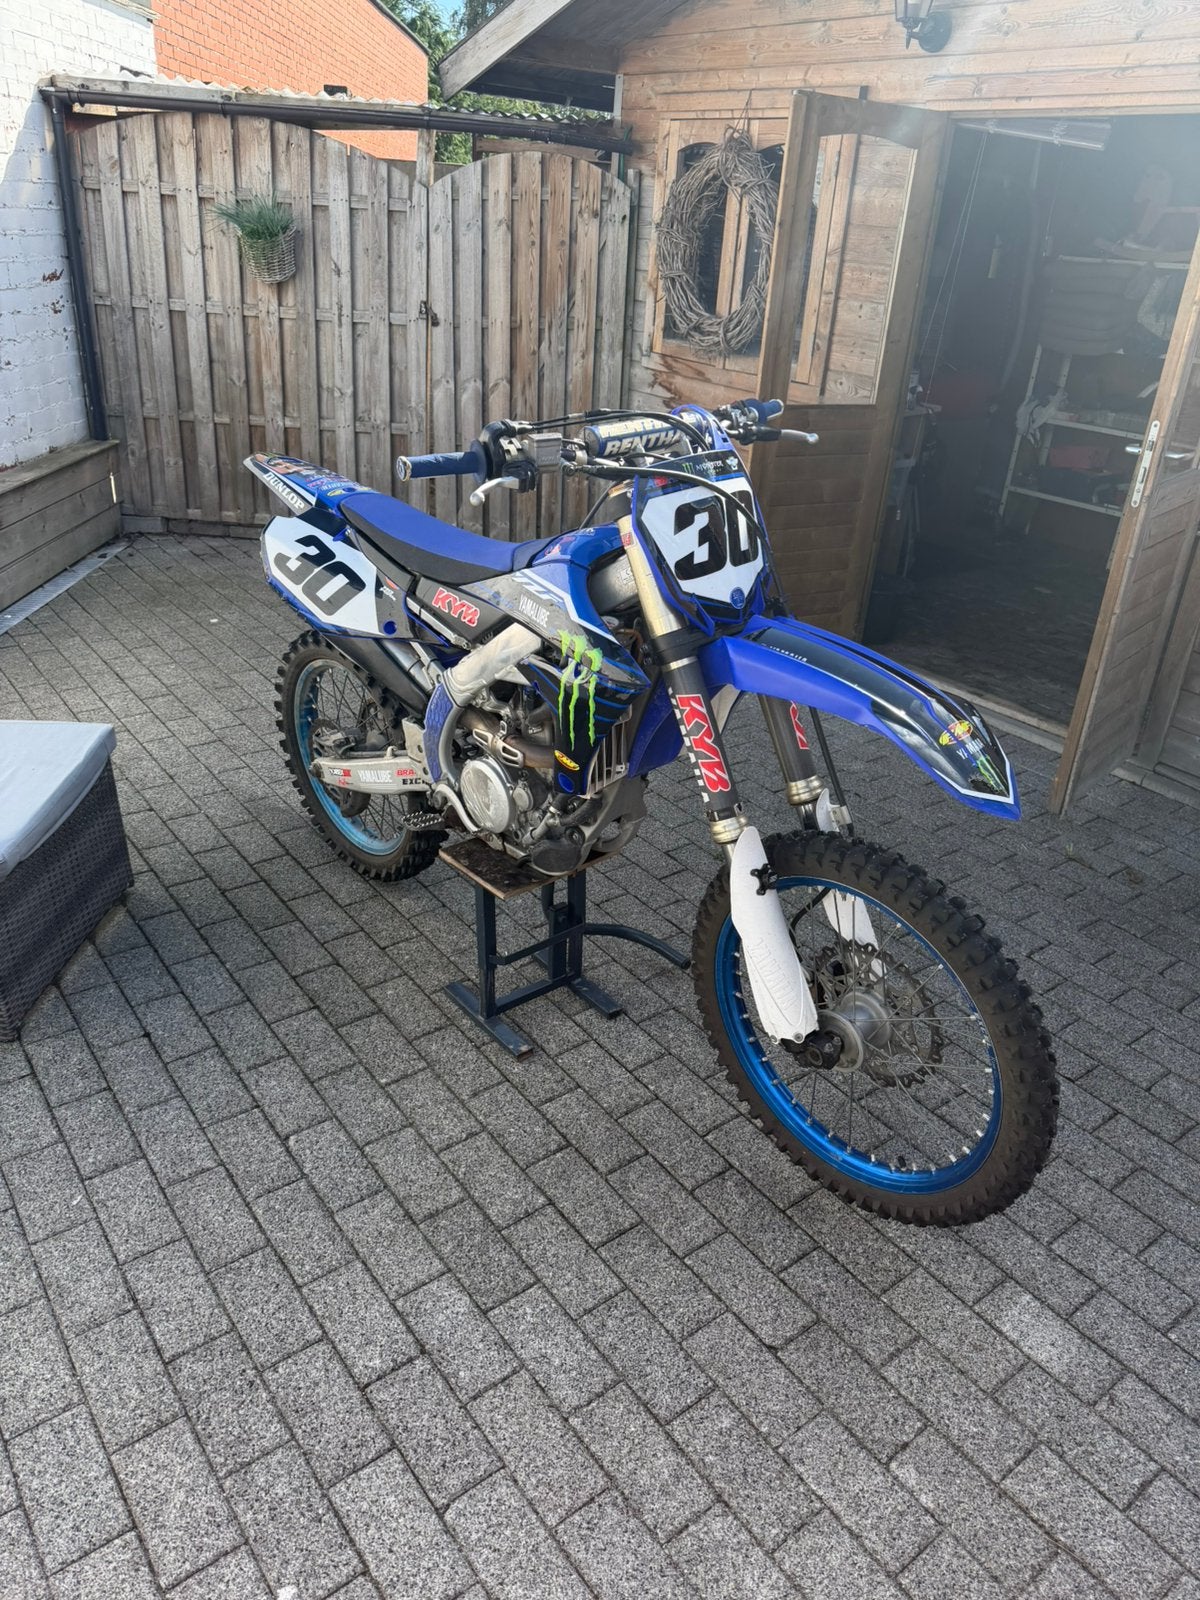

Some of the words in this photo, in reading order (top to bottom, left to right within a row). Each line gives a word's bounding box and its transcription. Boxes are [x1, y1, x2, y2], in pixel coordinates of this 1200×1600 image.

[263, 472, 306, 509] DUNLOP
[673, 489, 759, 581] 30
[273, 534, 367, 616] 30
[432, 587, 480, 627] KYB
[519, 594, 550, 628] YAMALUBE
[676, 693, 732, 793] KYB
[358, 769, 393, 783] YAMALUBE
[396, 768, 417, 777] BRA
